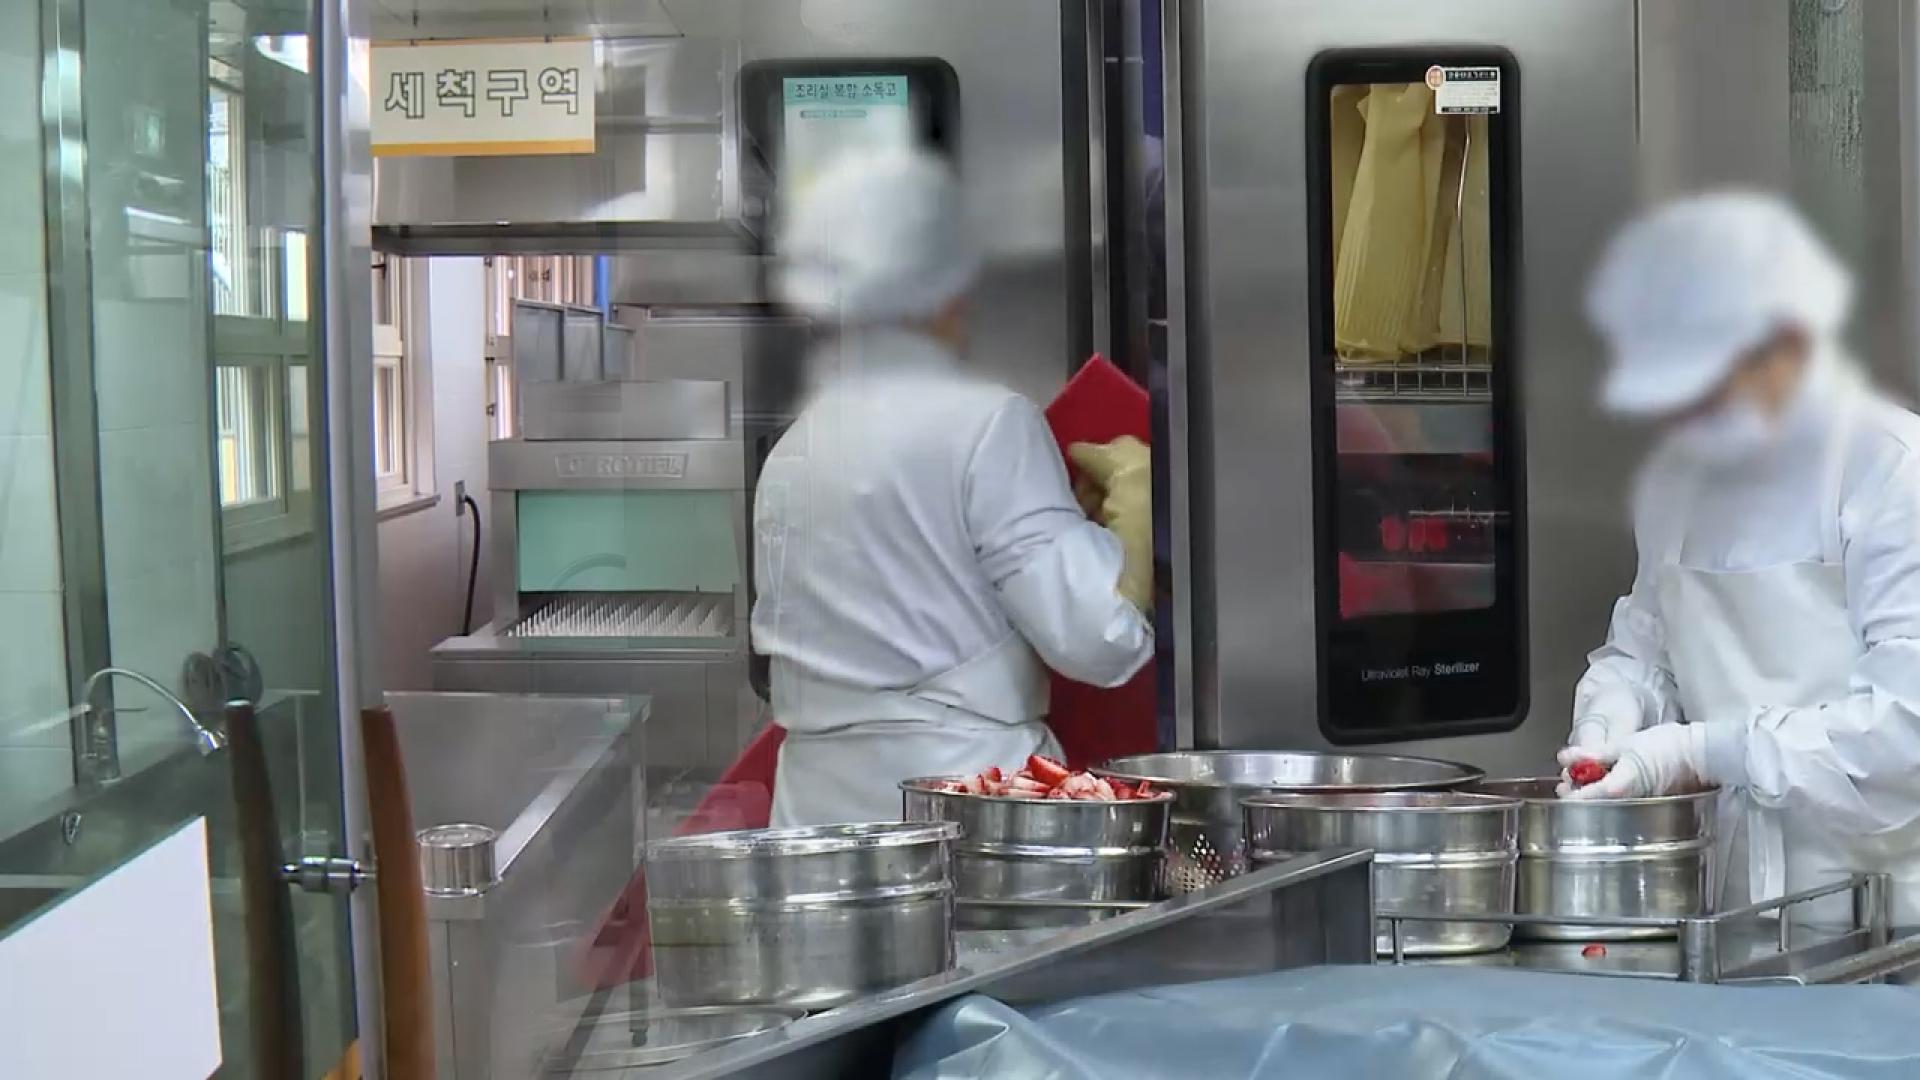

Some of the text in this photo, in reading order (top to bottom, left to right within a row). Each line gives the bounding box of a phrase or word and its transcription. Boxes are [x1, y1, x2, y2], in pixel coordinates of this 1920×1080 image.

[384, 67, 579, 119] 세척구역
[794, 83, 829, 99] 조리실
[862, 81, 897, 99] 소독고
[1411, 665, 1431, 679] Ray
[1434, 661, 1480, 675] Sterilizer
